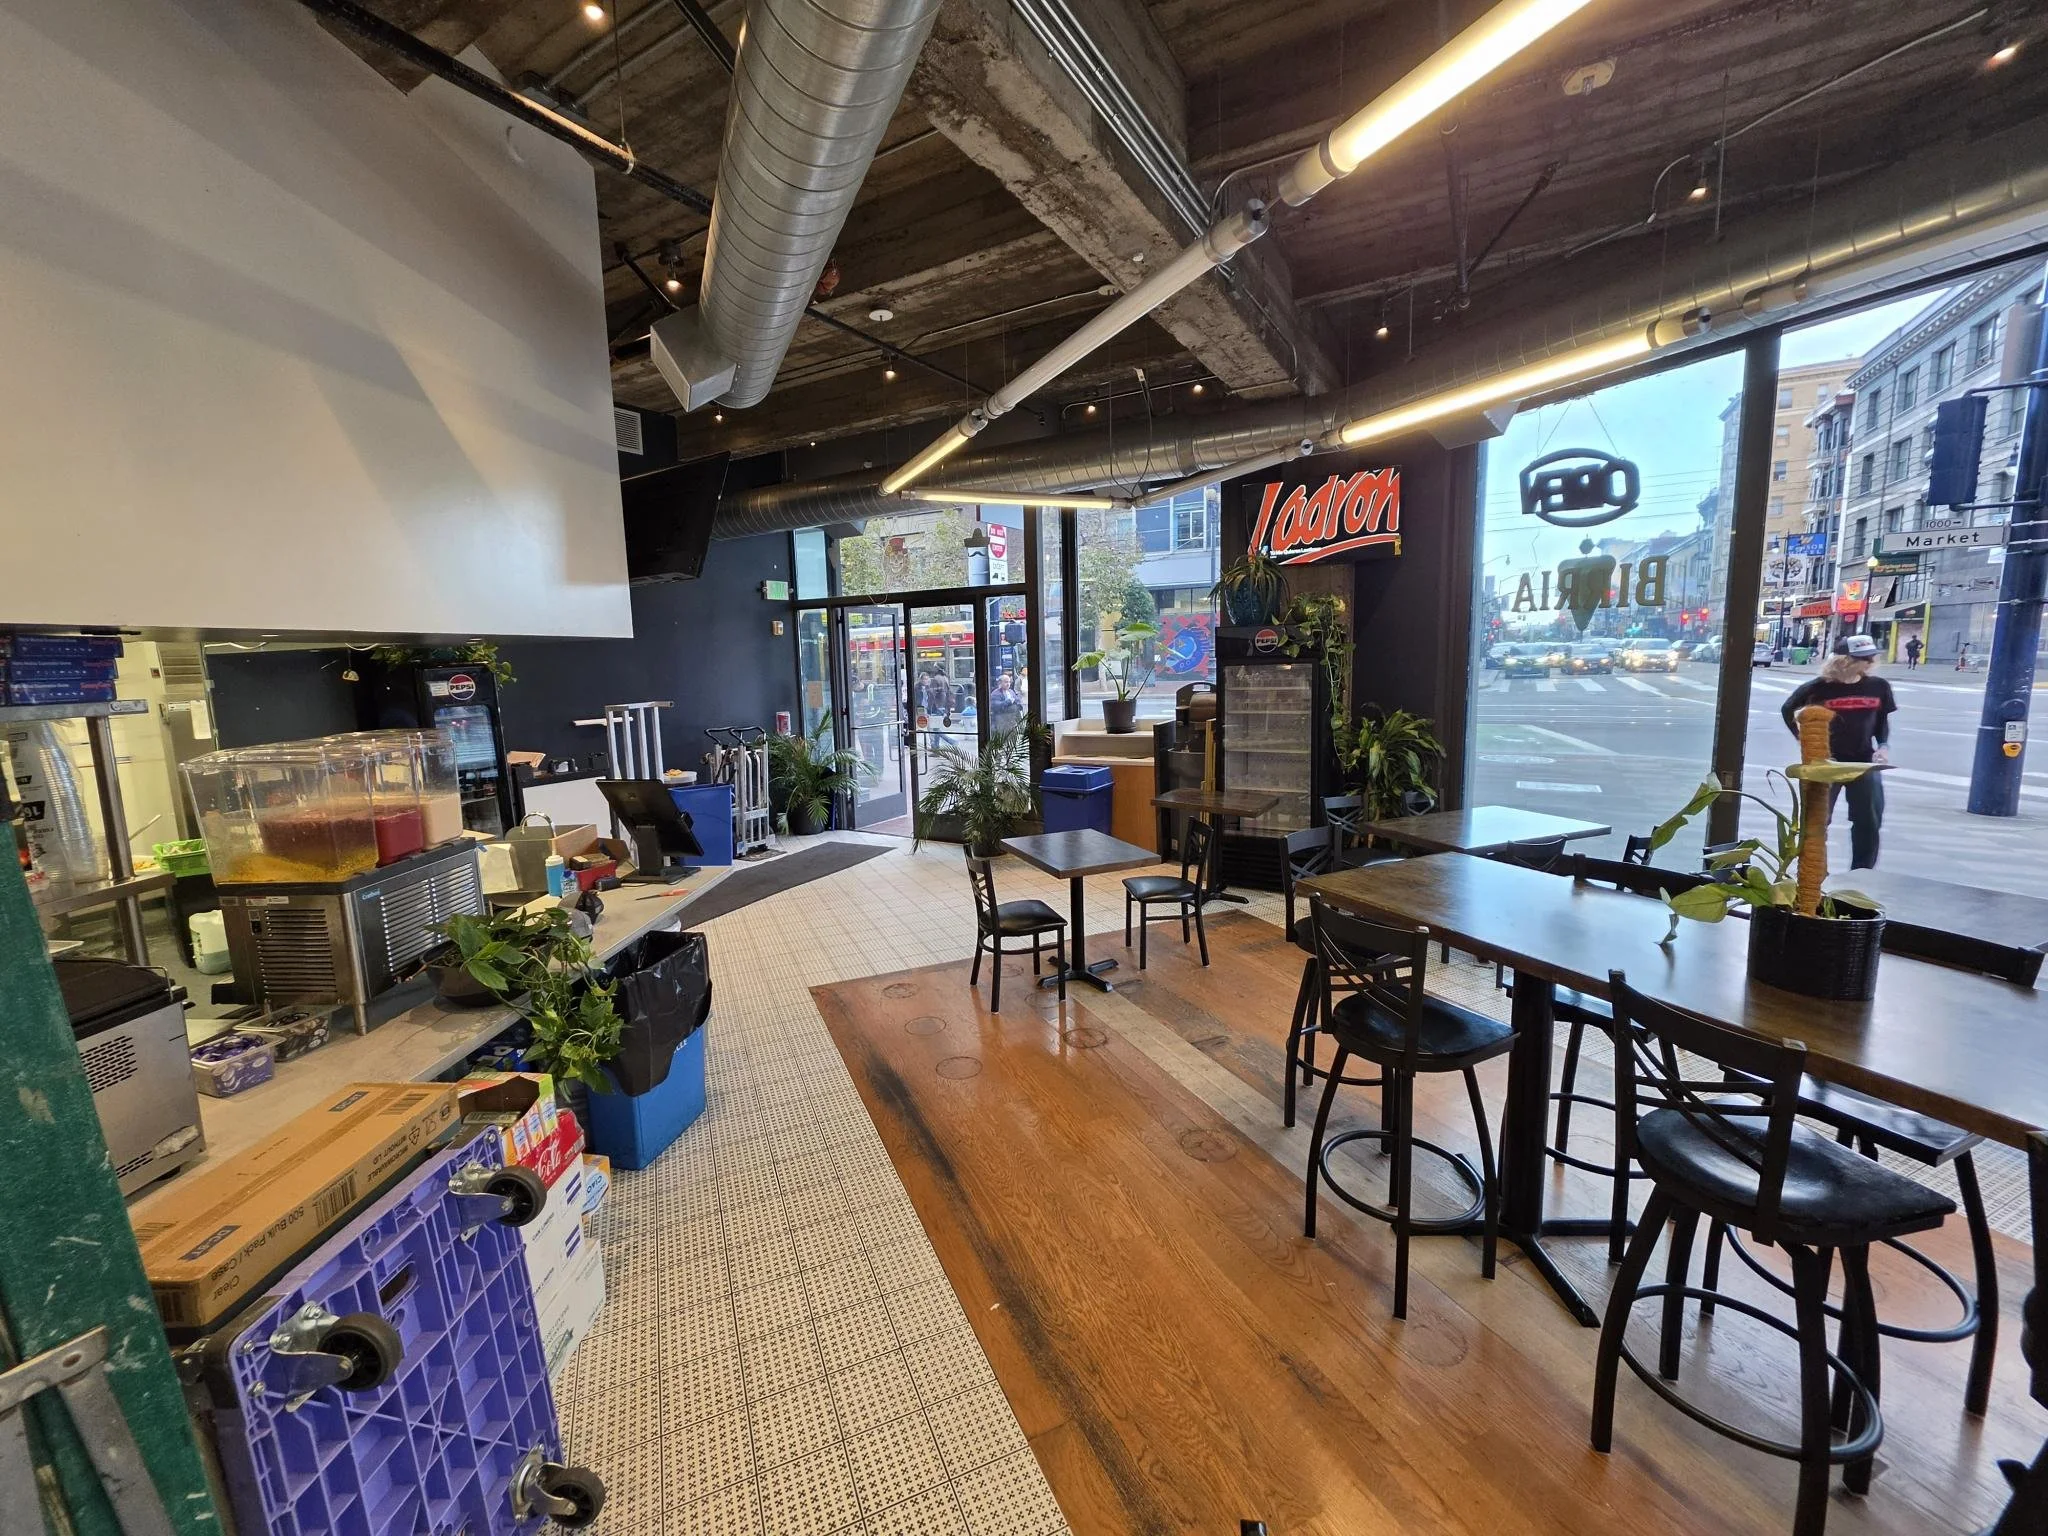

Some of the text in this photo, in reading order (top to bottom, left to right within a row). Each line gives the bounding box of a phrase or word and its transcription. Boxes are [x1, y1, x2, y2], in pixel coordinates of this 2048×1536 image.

[1926, 519, 1951, 528] 1000
[1906, 532, 1980, 547] Market
[586, 1175, 603, 1194] CIAO
[288, 1206, 305, 1224] 500
[267, 1219, 287, 1238] Bulk
[244, 1235, 266, 1256] Pack
[211, 1258, 238, 1281] Case
[213, 1274, 240, 1300] Clear
